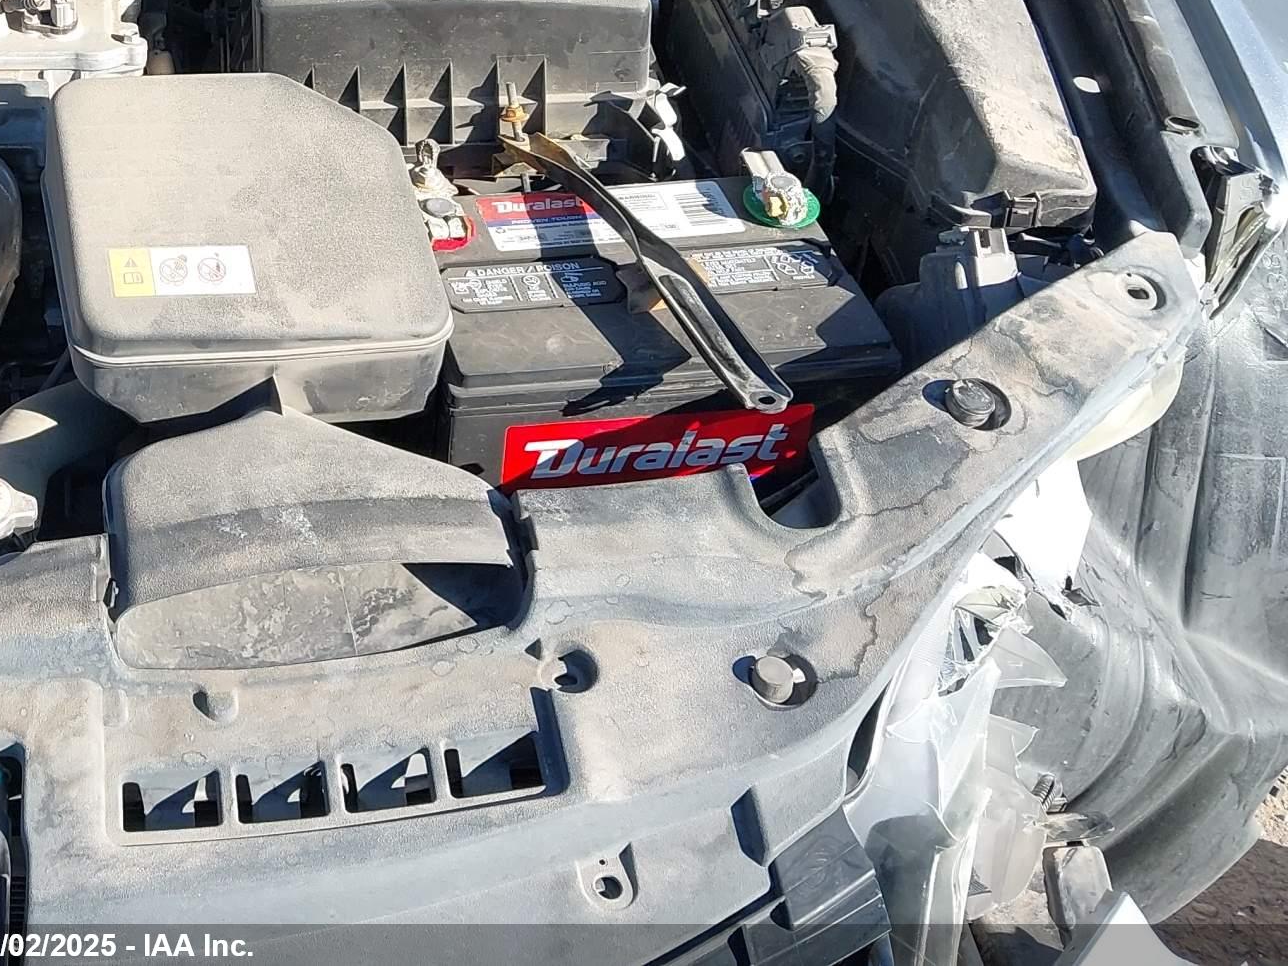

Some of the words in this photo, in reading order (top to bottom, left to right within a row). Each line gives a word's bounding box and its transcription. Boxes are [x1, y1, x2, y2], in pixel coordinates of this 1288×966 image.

[492, 197, 584, 214] Duralast
[477, 266, 524, 277] DANGER
[536, 262, 580, 272] POISON
[523, 423, 788, 479] Duralast
